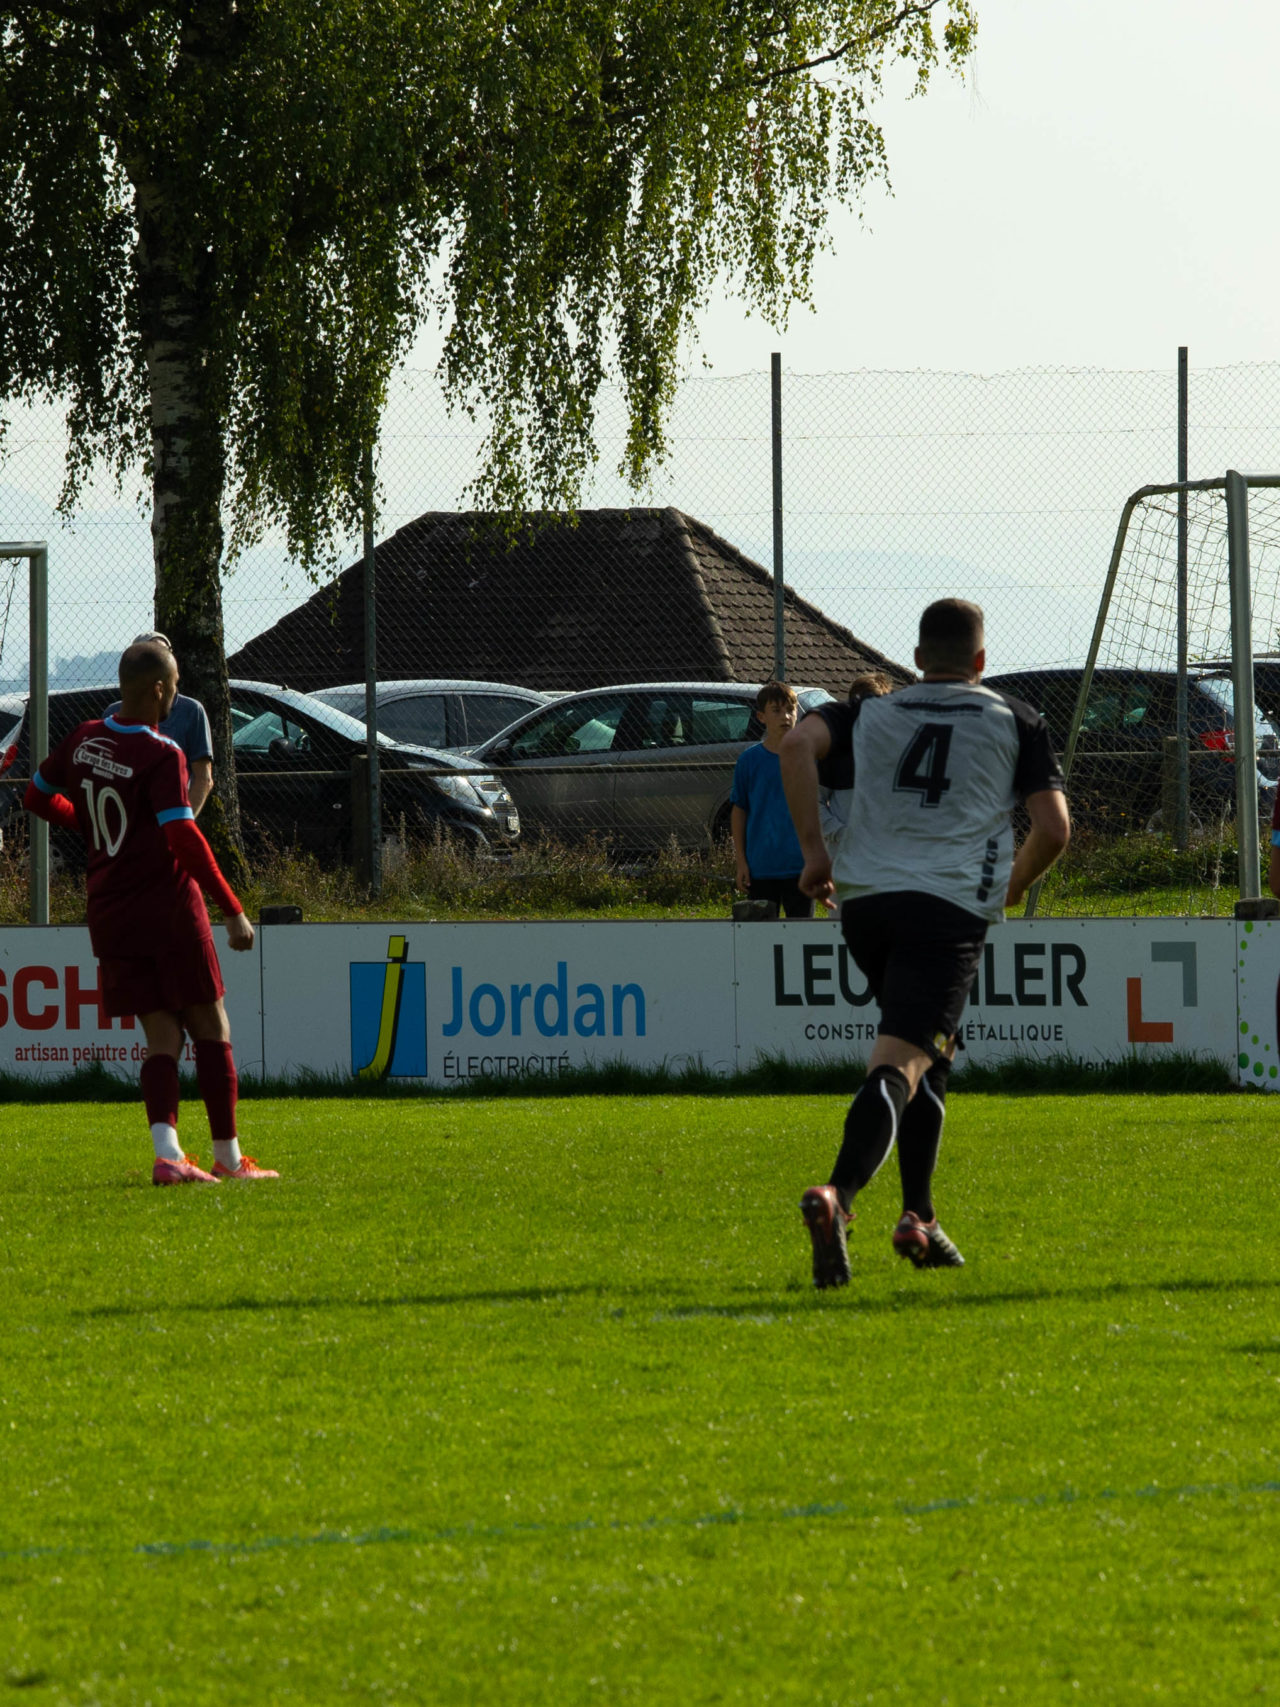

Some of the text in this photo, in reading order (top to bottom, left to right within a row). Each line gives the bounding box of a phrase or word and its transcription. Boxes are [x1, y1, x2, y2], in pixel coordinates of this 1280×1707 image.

[893, 723, 954, 809] 4
[81, 779, 127, 857] 10
[442, 961, 646, 1037] Jordan
[773, 943, 1089, 1007] LEULER
[15, 1042, 69, 1061] artisan
[73, 1042, 127, 1066] peintre
[443, 1050, 570, 1078] ÉLECTRICITÉ
